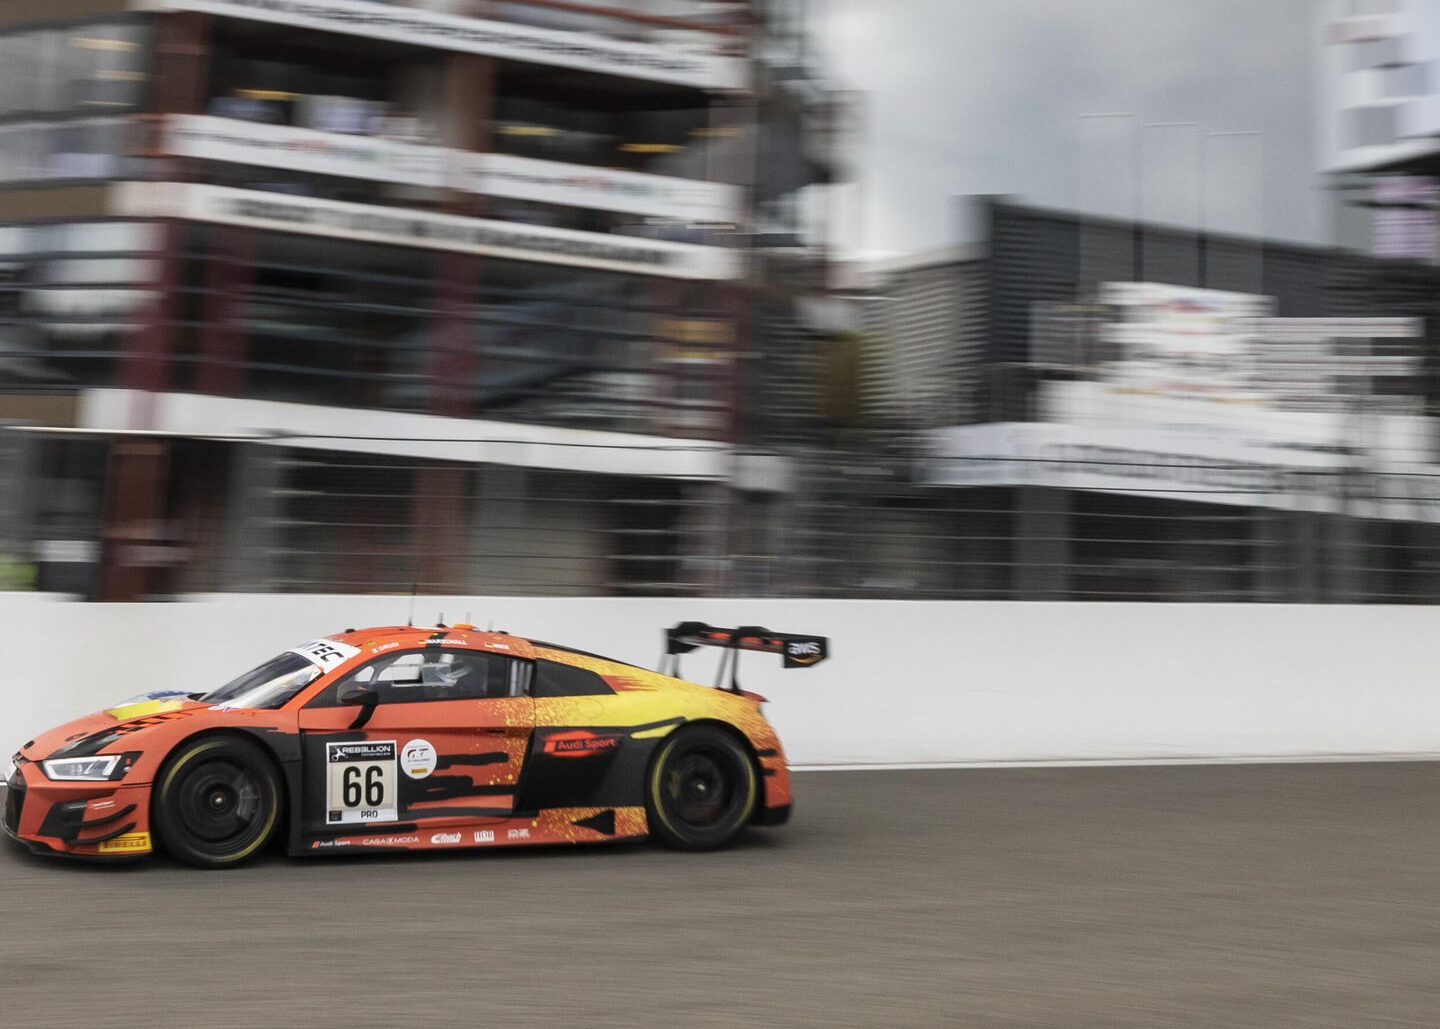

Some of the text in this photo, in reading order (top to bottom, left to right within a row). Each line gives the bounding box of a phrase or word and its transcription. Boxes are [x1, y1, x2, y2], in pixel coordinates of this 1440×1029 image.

[558, 738, 616, 750] Audi Sport
[342, 745, 391, 754] REBELLION
[343, 765, 384, 808] 66
[361, 811, 378, 819] PRO
